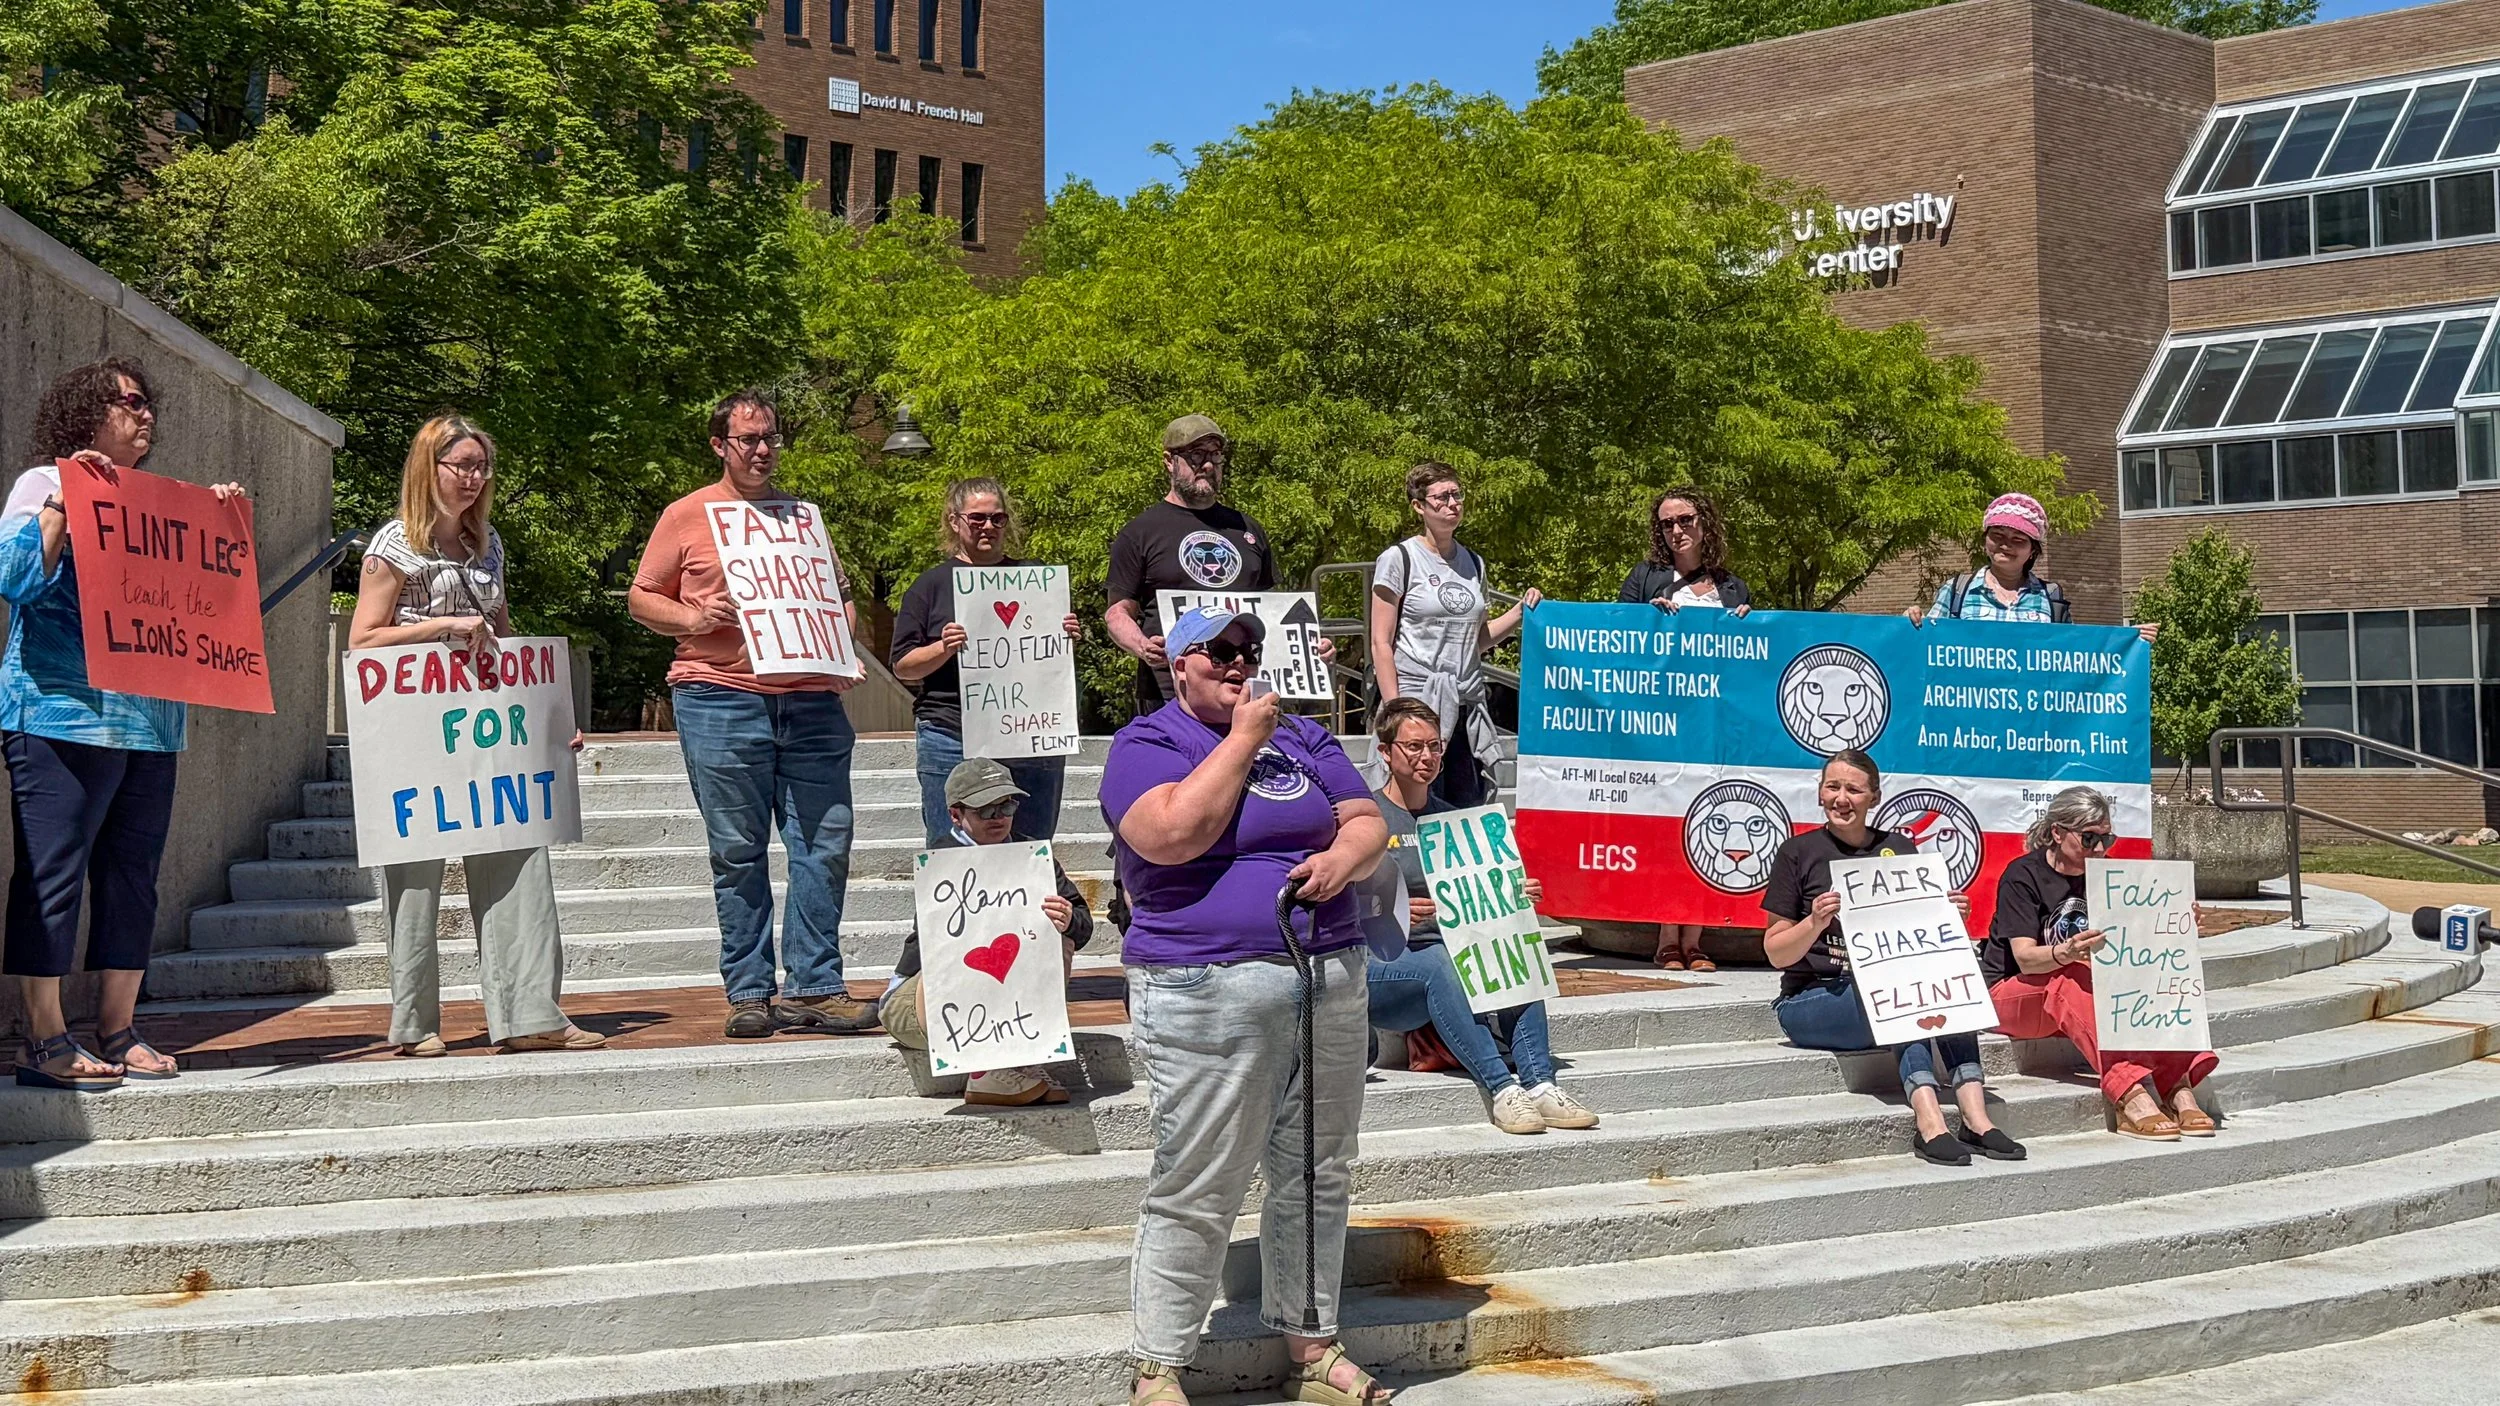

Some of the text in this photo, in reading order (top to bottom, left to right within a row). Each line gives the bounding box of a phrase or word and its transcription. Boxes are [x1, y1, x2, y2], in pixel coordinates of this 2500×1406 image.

[862, 92, 983, 124] David M. French Hall
[1792, 193, 1954, 242] Uiversity
[92, 500, 188, 562] FLINT
[713, 505, 821, 548] FAIR
[121, 567, 216, 617] teach the
[727, 555, 837, 604] SHARE
[956, 567, 1056, 594] UMMAP
[104, 611, 261, 676] LION'S SHARE
[743, 607, 846, 665] FLINT
[1545, 626, 1769, 660] UNIVERSITY OF MICHIGAN
[357, 646, 555, 704] DEARBORN
[1927, 644, 2127, 677] LECTURERS, LIBRARIANS,
[965, 682, 1028, 711] FAIR
[1544, 665, 1721, 698] NON-TENURE TRACK
[1923, 684, 2127, 714] ARCHIVISTS, & CURATORS
[442, 704, 528, 754] FOR
[1000, 712, 1061, 735] SHARE
[1543, 705, 1677, 736] FACULTY UNION
[1918, 724, 2128, 756] Ann Arbor, Dearborn, Flint
[1031, 735, 1077, 753] FLINT
[1561, 768, 1657, 786] AFT-MI Local 6244
[1589, 788, 1628, 803] AFL-CIO
[392, 771, 555, 838] FLINT
[1417, 812, 1519, 874] FAIR
[1578, 843, 1637, 872] LECS
[934, 868, 1027, 937] glam
[1435, 866, 1531, 929] SHARE
[1843, 866, 1943, 904] FAIR
[2105, 870, 2182, 909] Fair
[1851, 923, 1963, 961] SHARE
[2154, 912, 2191, 935] LEO
[1453, 931, 1549, 998] FLINT
[2094, 926, 2189, 971] Share
[1870, 973, 1975, 1016] FLINT
[2157, 977, 2201, 997] LECS
[942, 1001, 1039, 1052] flint
[2111, 989, 2191, 1032] Flint
